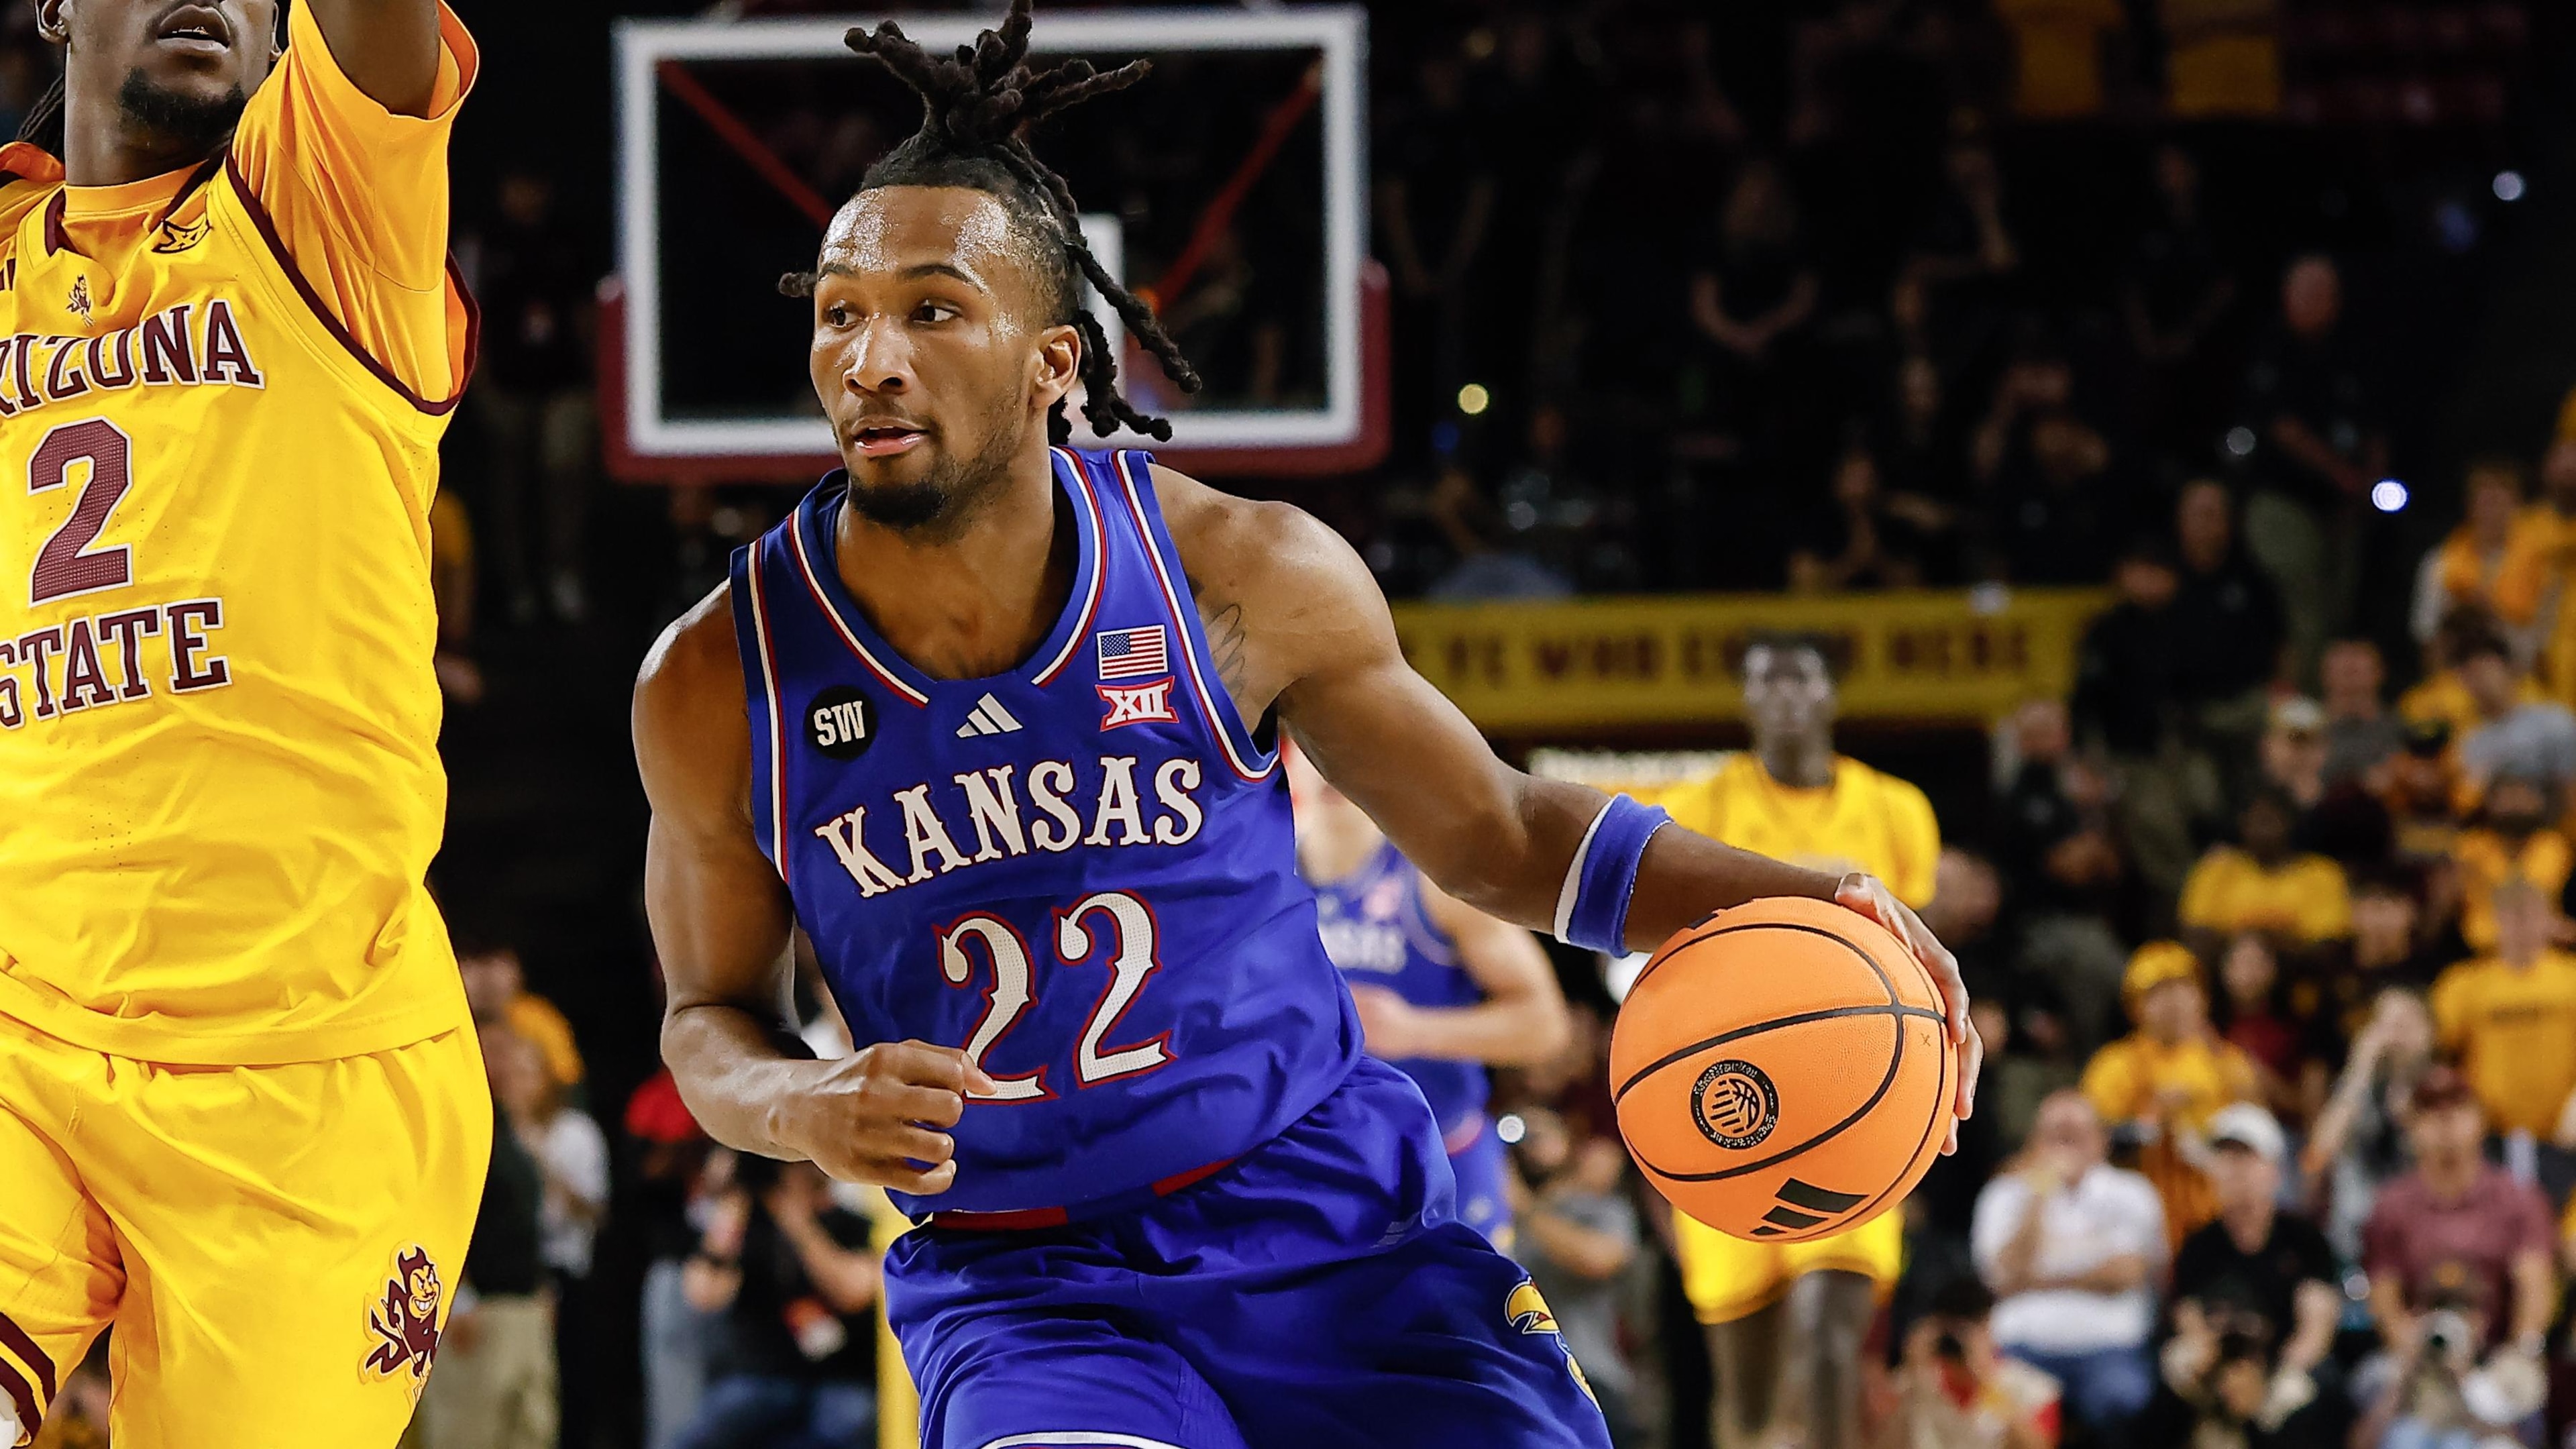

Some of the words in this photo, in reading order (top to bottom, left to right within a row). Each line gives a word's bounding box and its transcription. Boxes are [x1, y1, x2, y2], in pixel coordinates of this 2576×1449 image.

[0, 299, 266, 419] IZONA
[27, 415, 132, 608] 2
[0, 598, 233, 730] STATE
[814, 700, 865, 746] SW
[1096, 678, 1178, 730] XII
[813, 755, 1203, 899] KANSAS
[933, 890, 1177, 1104] 22
